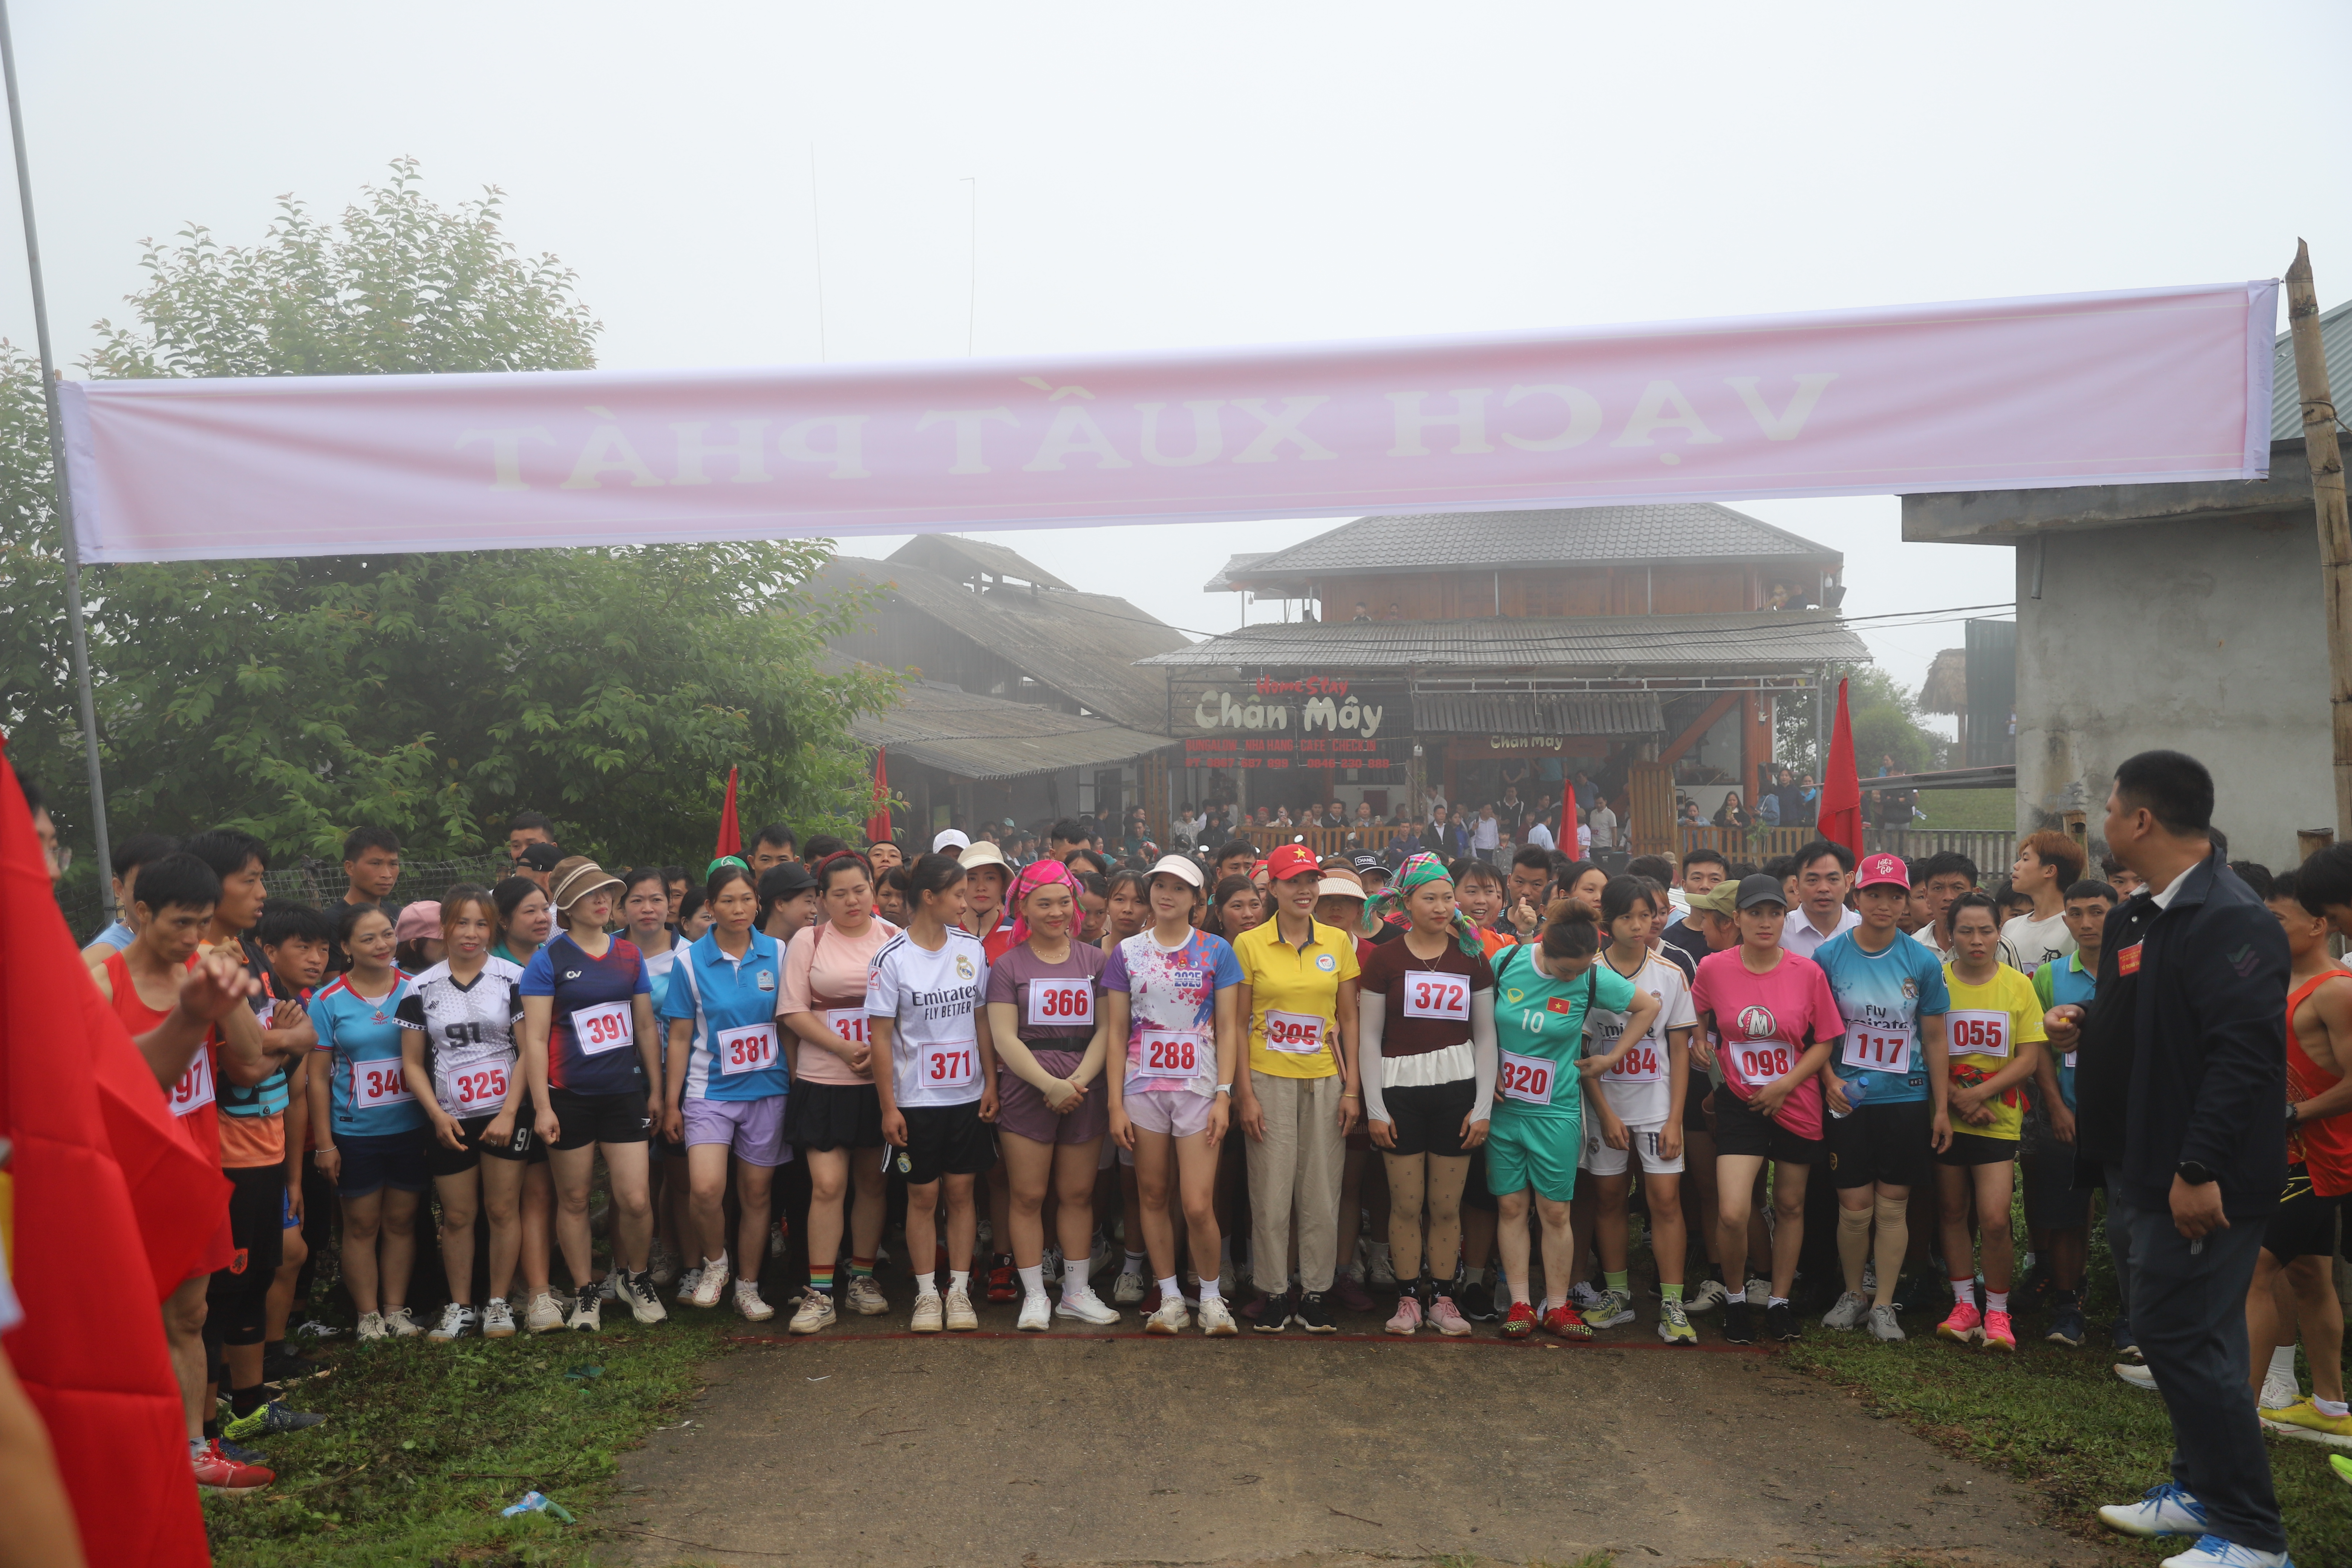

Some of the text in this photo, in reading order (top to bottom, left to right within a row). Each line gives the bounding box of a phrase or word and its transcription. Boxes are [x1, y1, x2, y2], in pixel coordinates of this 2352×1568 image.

[1196, 690, 1383, 737] Chân Mây
[1186, 739, 1237, 751] BUNGALOW
[1301, 739, 1326, 751] CAFE
[1241, 758, 1262, 768] 687
[1267, 758, 1288, 768] 899
[1307, 759, 1335, 768] 0846
[1341, 759, 1362, 768] 230
[1368, 759, 1389, 768] 888
[1880, 866, 1893, 875] GO
[1174, 971, 1201, 988] 2025
[912, 985, 976, 1006] Emirates
[1043, 989, 1088, 1016] 366
[1415, 982, 1463, 1011] 372
[925, 1001, 972, 1020] FLY BETTER
[1522, 1008, 1544, 1033] 10
[1866, 1005, 1886, 1017] Fly
[445, 1021, 482, 1047] 91
[586, 1012, 628, 1043] 391
[1271, 1020, 1317, 1045] 305
[1954, 1020, 2001, 1047] 055
[731, 1034, 770, 1065] 381
[1150, 1041, 1195, 1069] 288
[1857, 1033, 1904, 1063] 117
[931, 1050, 971, 1080] 371
[1742, 1049, 1788, 1076] 098
[166, 1059, 203, 1103] 97
[458, 1069, 506, 1102] 325
[1504, 1062, 1547, 1095] 320
[514, 1128, 533, 1152] 91
